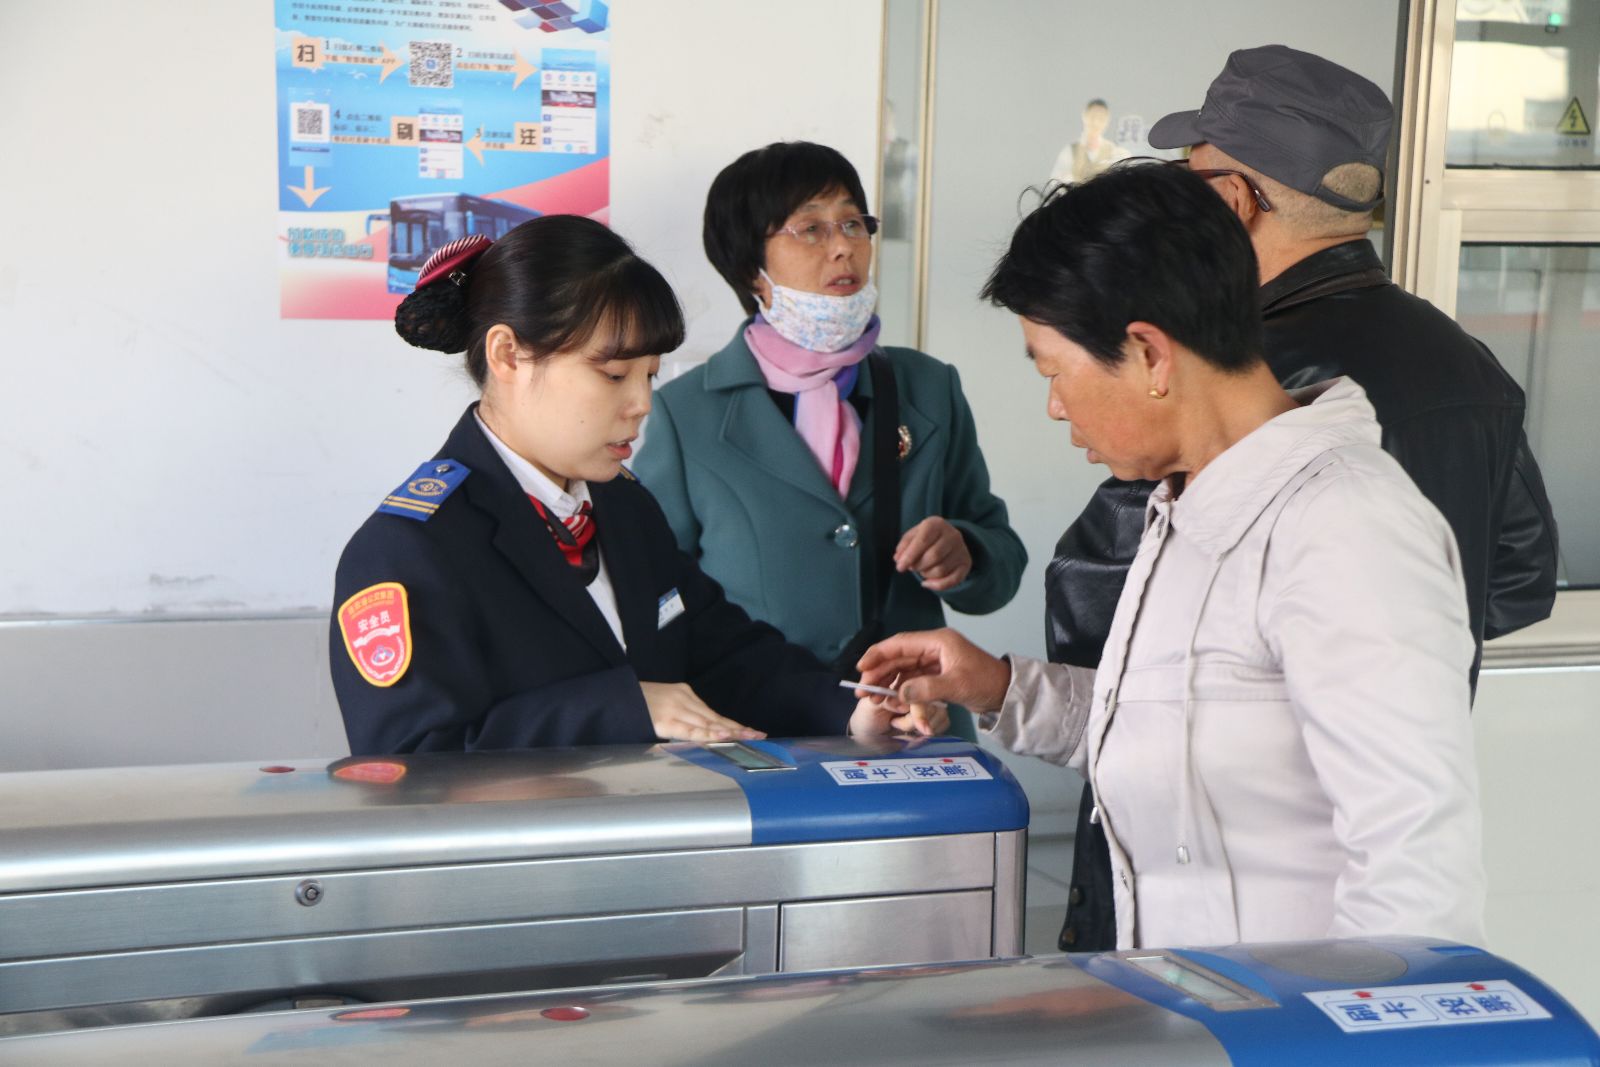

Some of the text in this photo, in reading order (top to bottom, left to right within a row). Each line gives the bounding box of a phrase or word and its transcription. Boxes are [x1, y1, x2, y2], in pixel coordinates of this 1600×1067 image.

[297, 44, 315, 63] 扫
[456, 48, 463, 58] 2
[334, 109, 341, 119] 4
[358, 610, 391, 633] 安全员
[839, 764, 970, 780] 刷卡 投票
[1337, 994, 1518, 1022] 刷卡 投票
